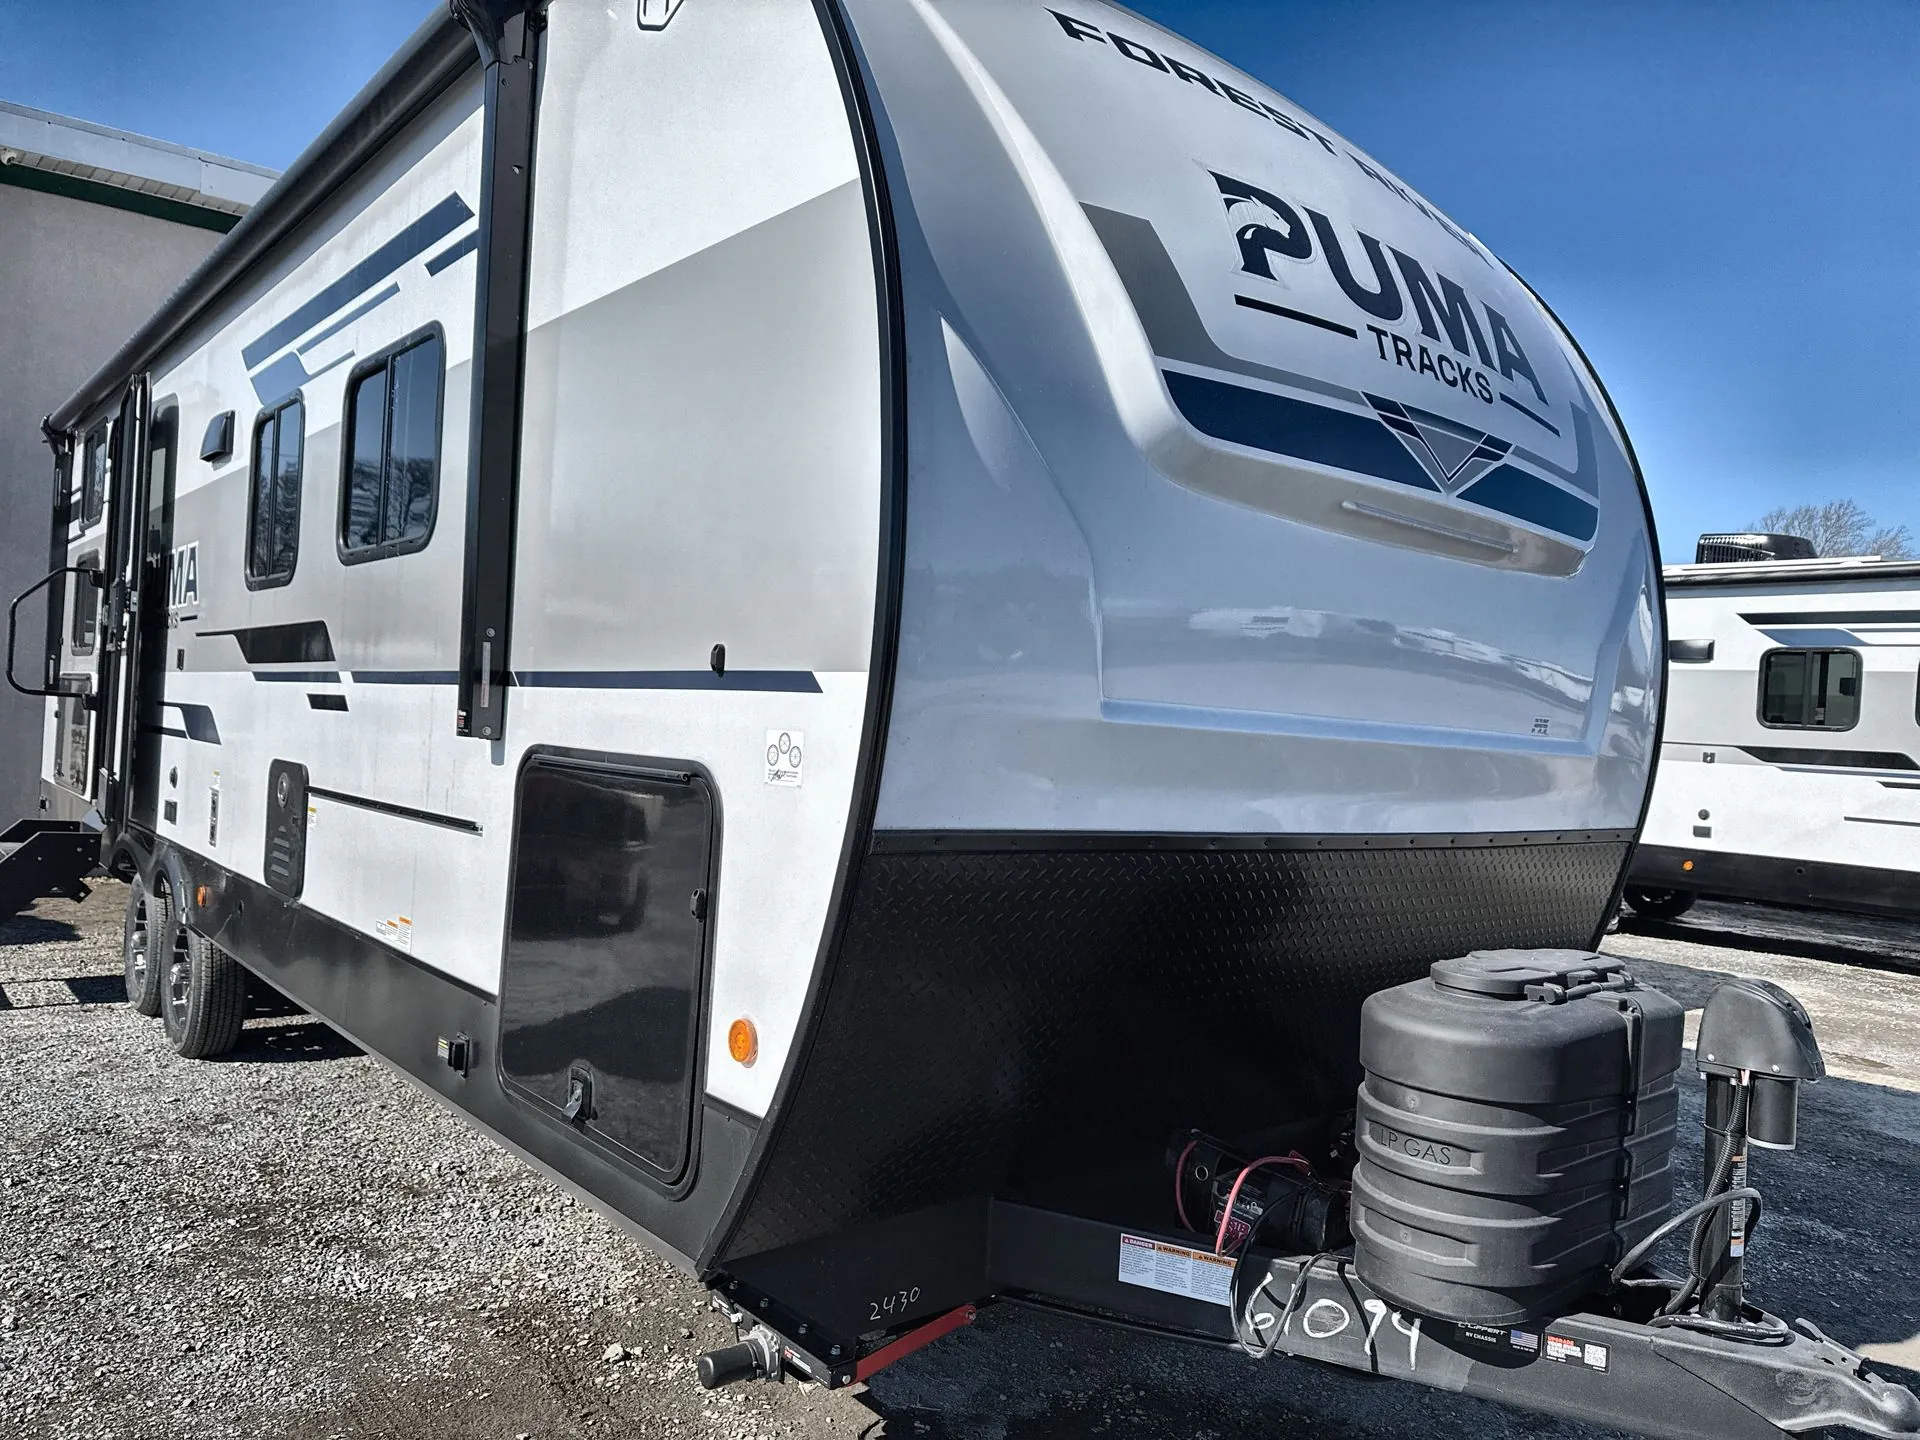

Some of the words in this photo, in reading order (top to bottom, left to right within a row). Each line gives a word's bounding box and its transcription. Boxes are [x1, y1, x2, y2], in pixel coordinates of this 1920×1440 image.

[1046, 8, 1338, 156] FOREST
[1206, 167, 1549, 405] PUMA
[1366, 324, 1494, 405] TRACKS
[168, 541, 199, 609] MA
[1381, 1127, 1399, 1149] LP
[1403, 1137, 1452, 1166] GAS
[1129, 1238, 1153, 1249] DANGER
[1162, 1246, 1191, 1257] WARNING
[1203, 1255, 1232, 1266] WARNING
[869, 1286, 921, 1320] 2430
[1473, 1333, 1497, 1343] CHASSIS
[1547, 1335, 1575, 1346] UPGRADE
